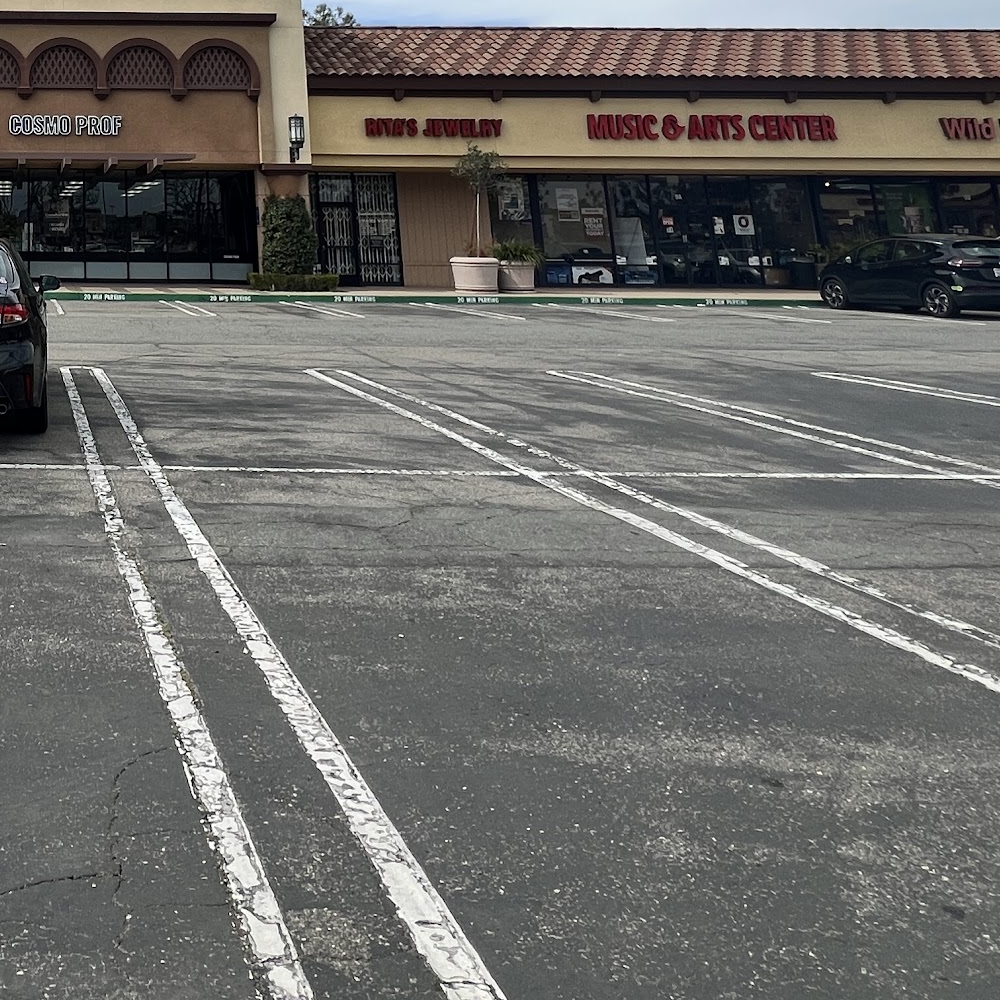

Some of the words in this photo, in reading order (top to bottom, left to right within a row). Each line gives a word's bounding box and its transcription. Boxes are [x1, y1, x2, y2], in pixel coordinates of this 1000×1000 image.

[8, 114, 72, 136] COSMO
[75, 115, 122, 136] PROF
[364, 118, 418, 137] RITA'S
[422, 118, 503, 138] JEWELRY
[586, 113, 659, 140] MUSIC
[661, 113, 686, 141] &
[687, 114, 746, 141] ARTS
[748, 114, 838, 141] CENTER
[938, 117, 995, 140] Wild
